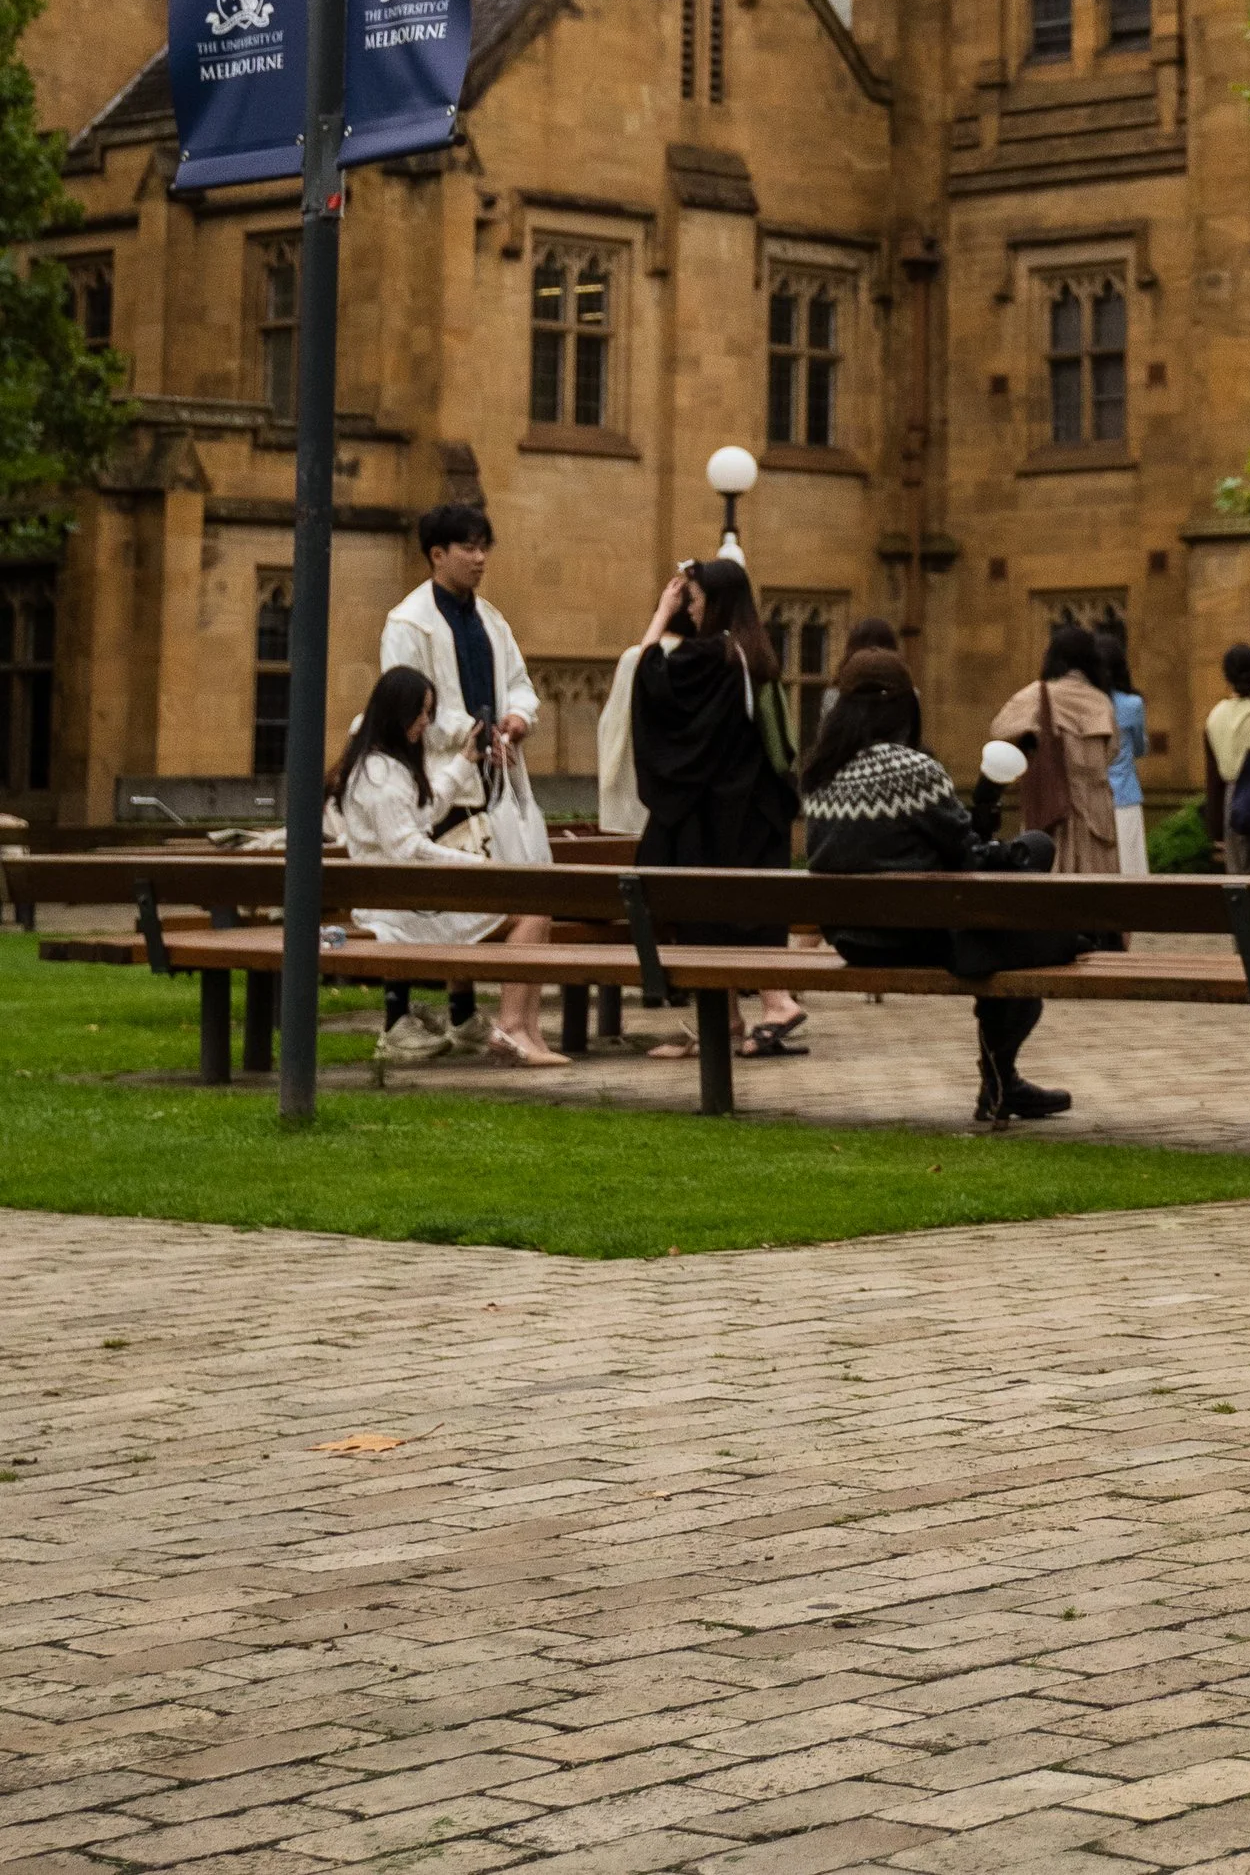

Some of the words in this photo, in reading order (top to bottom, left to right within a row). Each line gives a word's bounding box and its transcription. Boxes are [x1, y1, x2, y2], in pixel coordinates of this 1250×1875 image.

[365, 8, 382, 22] THE
[384, 1, 436, 20] UNIVERSITY
[197, 41, 217, 55] THE
[271, 30, 284, 44] OF
[365, 22, 447, 51] MELBOURNE
[200, 52, 284, 82] MELBOURNE
